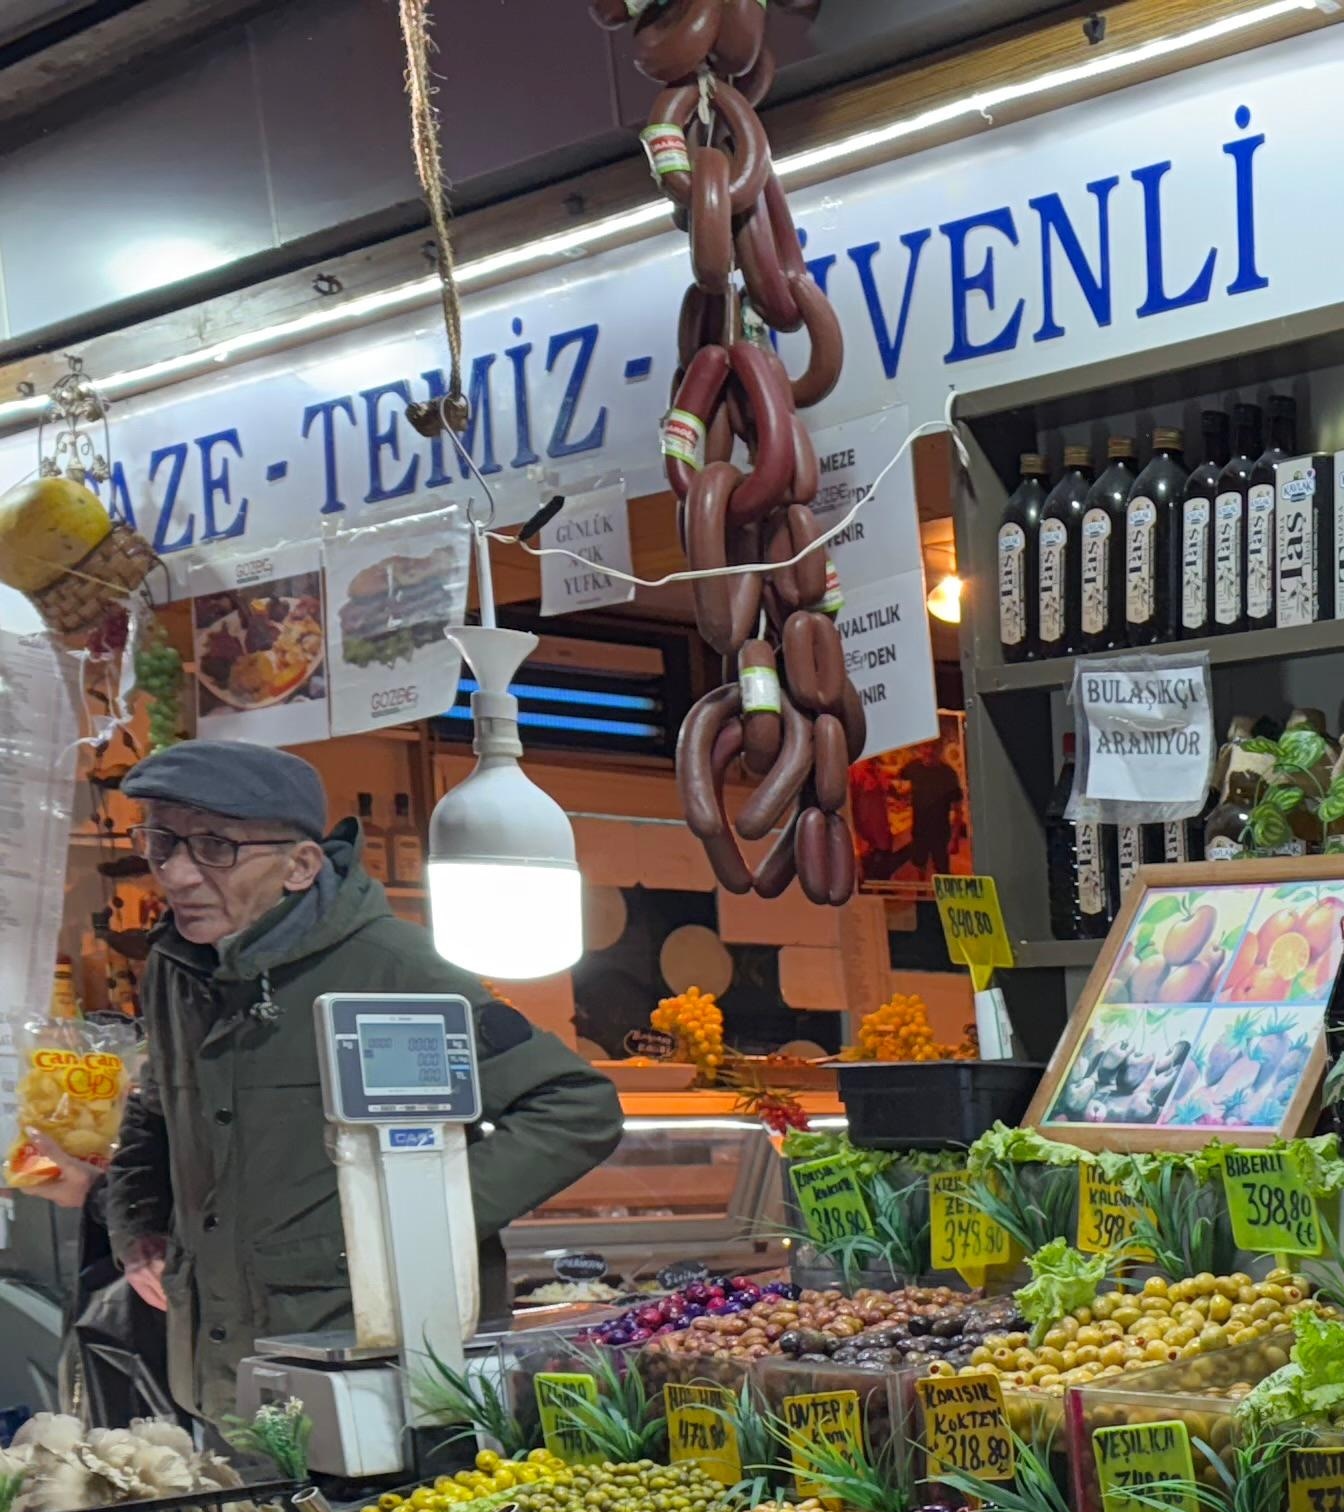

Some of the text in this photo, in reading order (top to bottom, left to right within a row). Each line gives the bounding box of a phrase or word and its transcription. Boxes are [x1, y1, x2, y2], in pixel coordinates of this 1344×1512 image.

[819, 449, 856, 475] MEZE
[1087, 678, 1199, 711] BULAŞIKÇI
[1095, 728, 1201, 757] ARANIYOR
